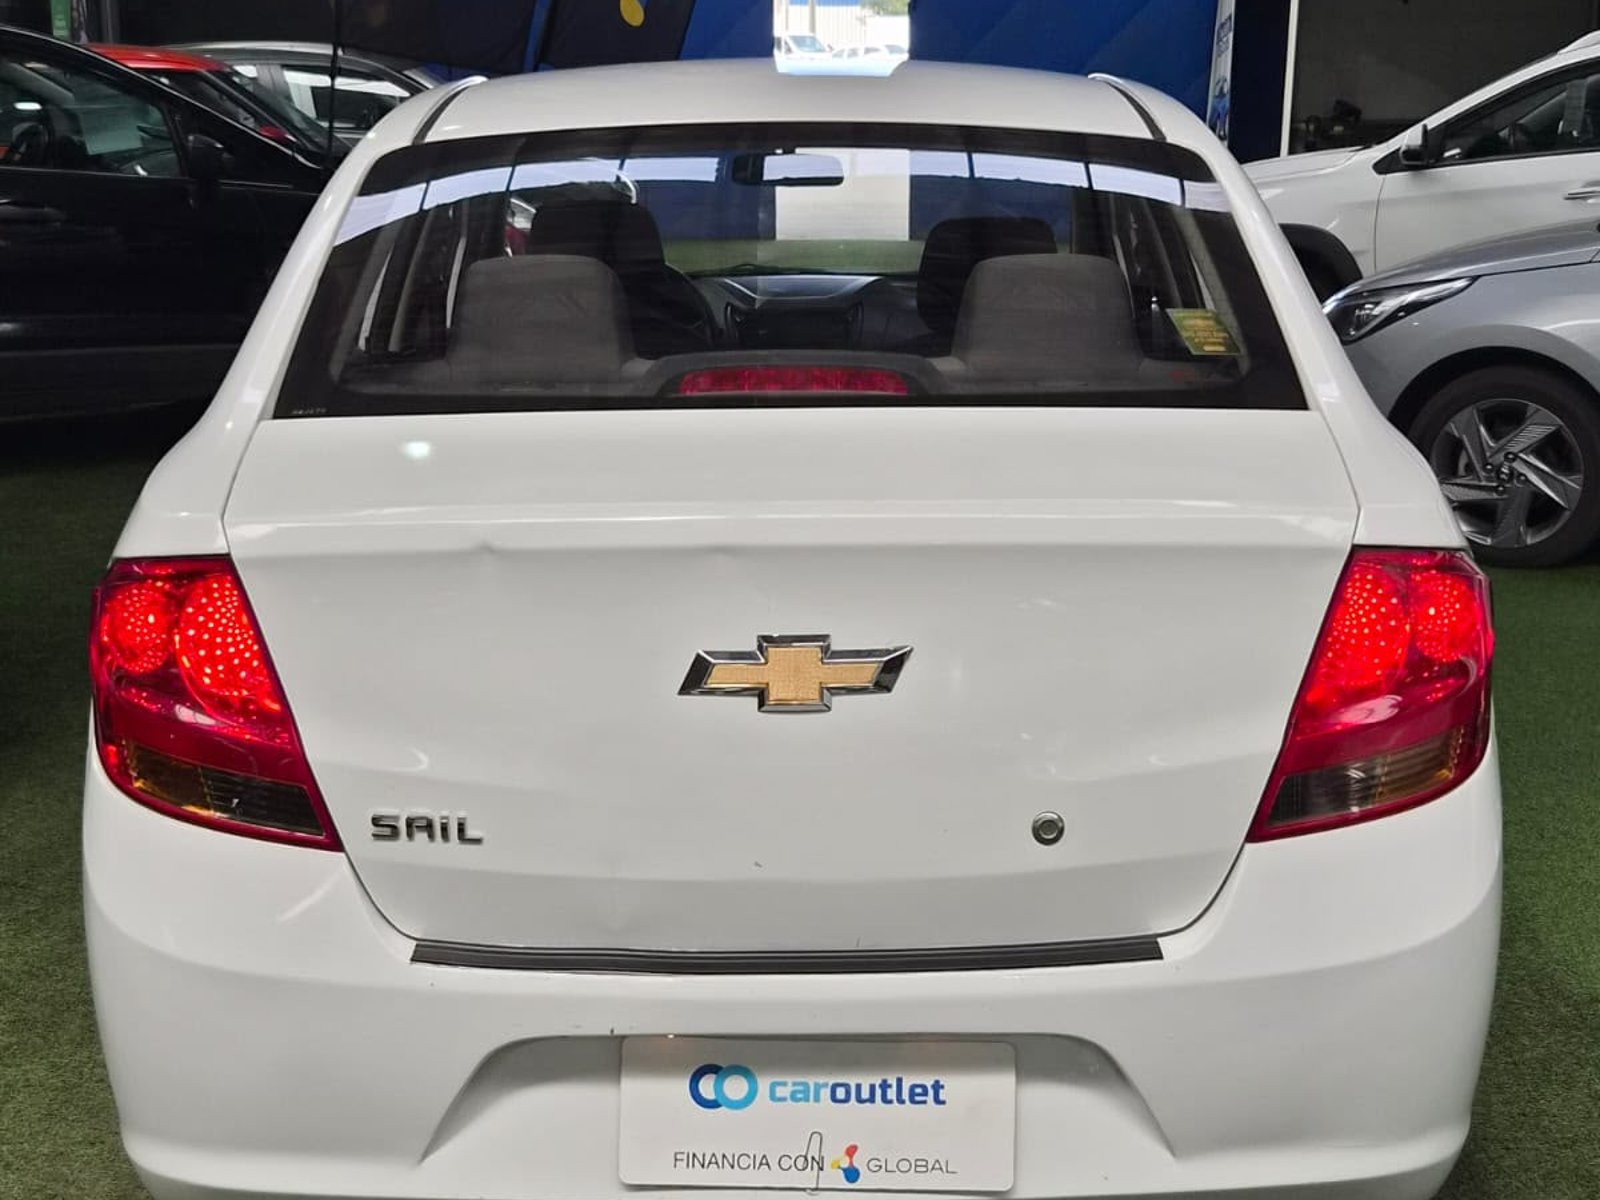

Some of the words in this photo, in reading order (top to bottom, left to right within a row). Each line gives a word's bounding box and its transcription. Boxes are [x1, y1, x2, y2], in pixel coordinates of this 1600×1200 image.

[768, 1076, 947, 1106] caroutlet
[672, 1151, 772, 1172] FINANCIA
[777, 1154, 825, 1173] CON
[866, 1157, 958, 1175] GLOBAL
